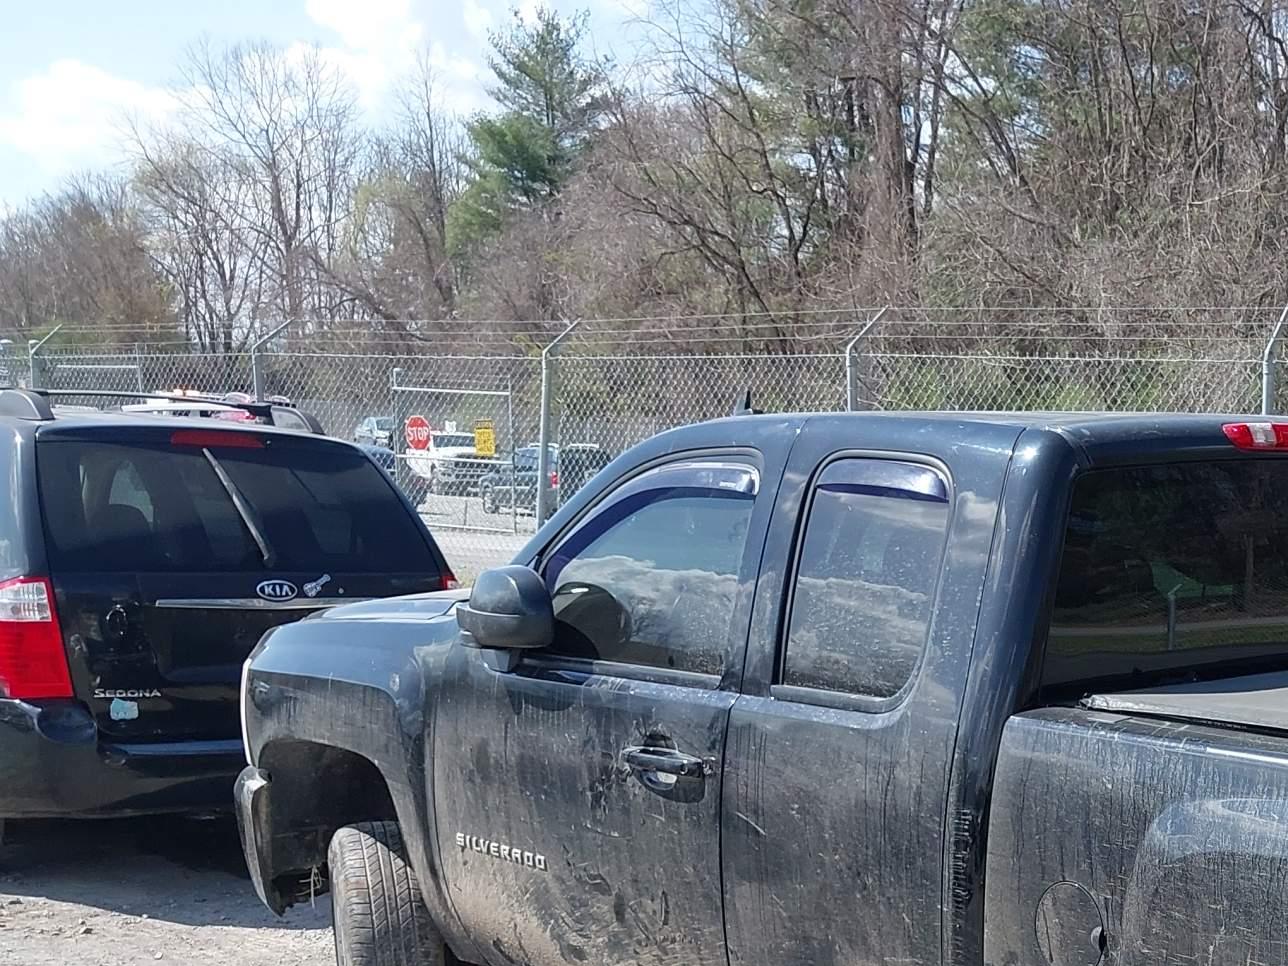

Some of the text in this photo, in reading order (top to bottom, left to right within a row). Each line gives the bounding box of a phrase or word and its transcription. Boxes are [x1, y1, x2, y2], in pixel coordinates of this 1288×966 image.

[407, 427, 429, 441] STOP
[262, 583, 293, 597] KIA
[93, 688, 162, 698] SEDONA
[455, 832, 546, 870] SILVERADO
